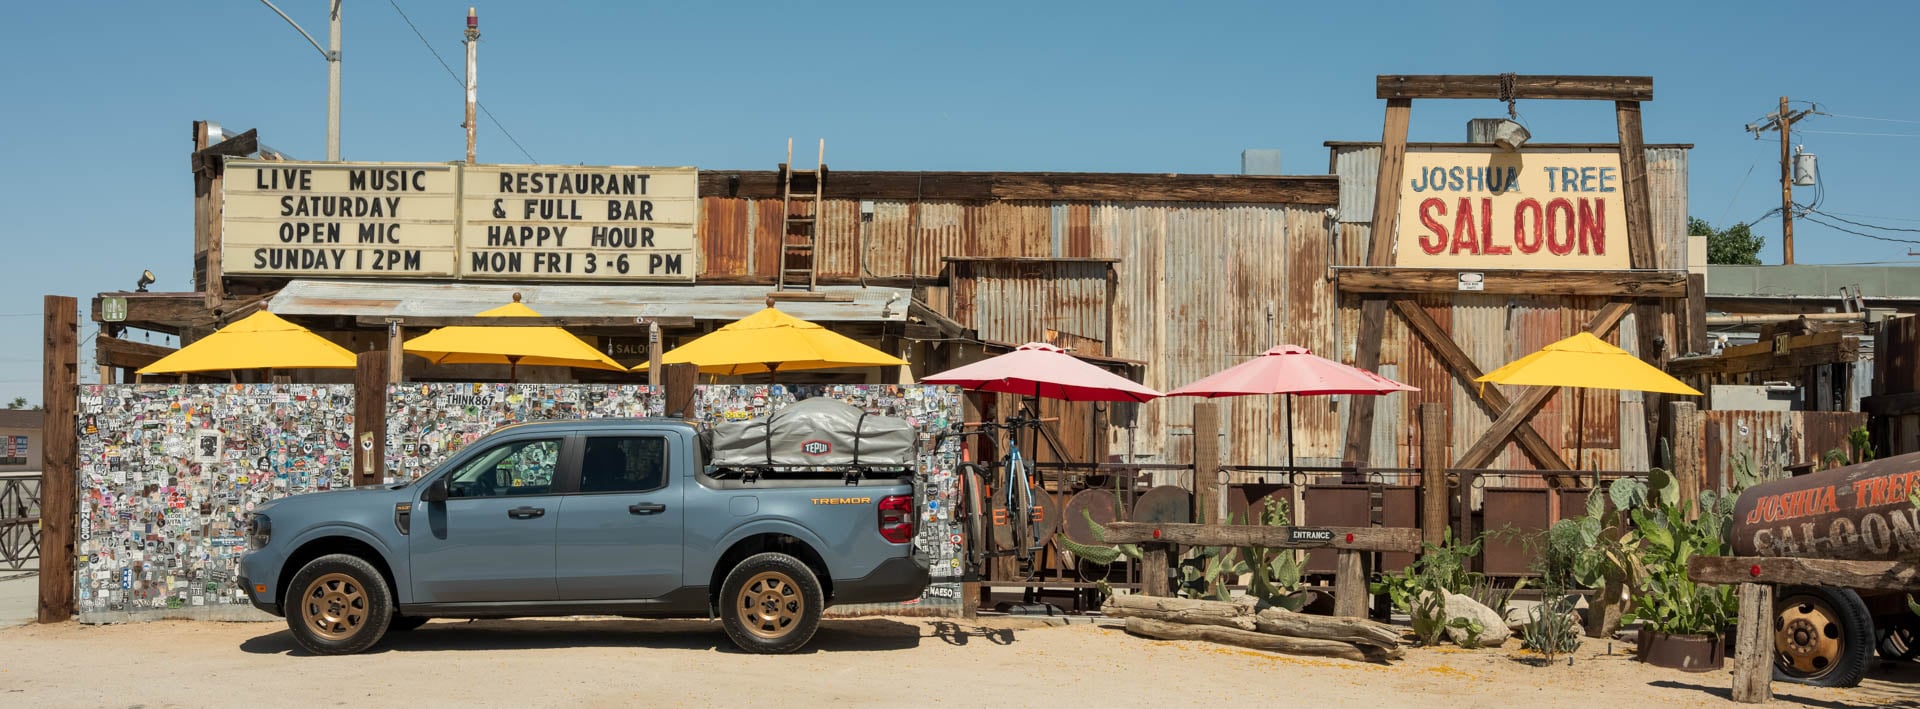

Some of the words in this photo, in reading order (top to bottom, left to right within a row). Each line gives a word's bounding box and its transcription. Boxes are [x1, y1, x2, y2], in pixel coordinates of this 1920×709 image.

[257, 168, 312, 191] LIVE
[350, 170, 426, 191] MUSIC
[500, 172, 650, 195] RESTAURANT
[1411, 165, 1520, 193] JOSHUA
[1543, 166, 1617, 193] TREE
[280, 195, 401, 218] SATURDAY
[492, 199, 506, 219] &
[524, 199, 582, 220] FULL
[608, 200, 653, 221] BAR
[279, 222, 340, 243] OPEN
[358, 223, 400, 244] MIC
[487, 225, 568, 247] HAPPY
[591, 226, 655, 248] HOUR
[1418, 196, 1606, 257] SALOON
[254, 248, 346, 270] SUNDAY
[472, 251, 522, 273] MON
[533, 252, 573, 273] FRI
[649, 254, 682, 275] PM
[447, 394, 495, 406] THINK867
[805, 442, 828, 453] TEPUI
[811, 497, 871, 505] TREMOR
[1746, 485, 1840, 525] JOSHUA
[1293, 531, 1330, 539] ENTRANCE
